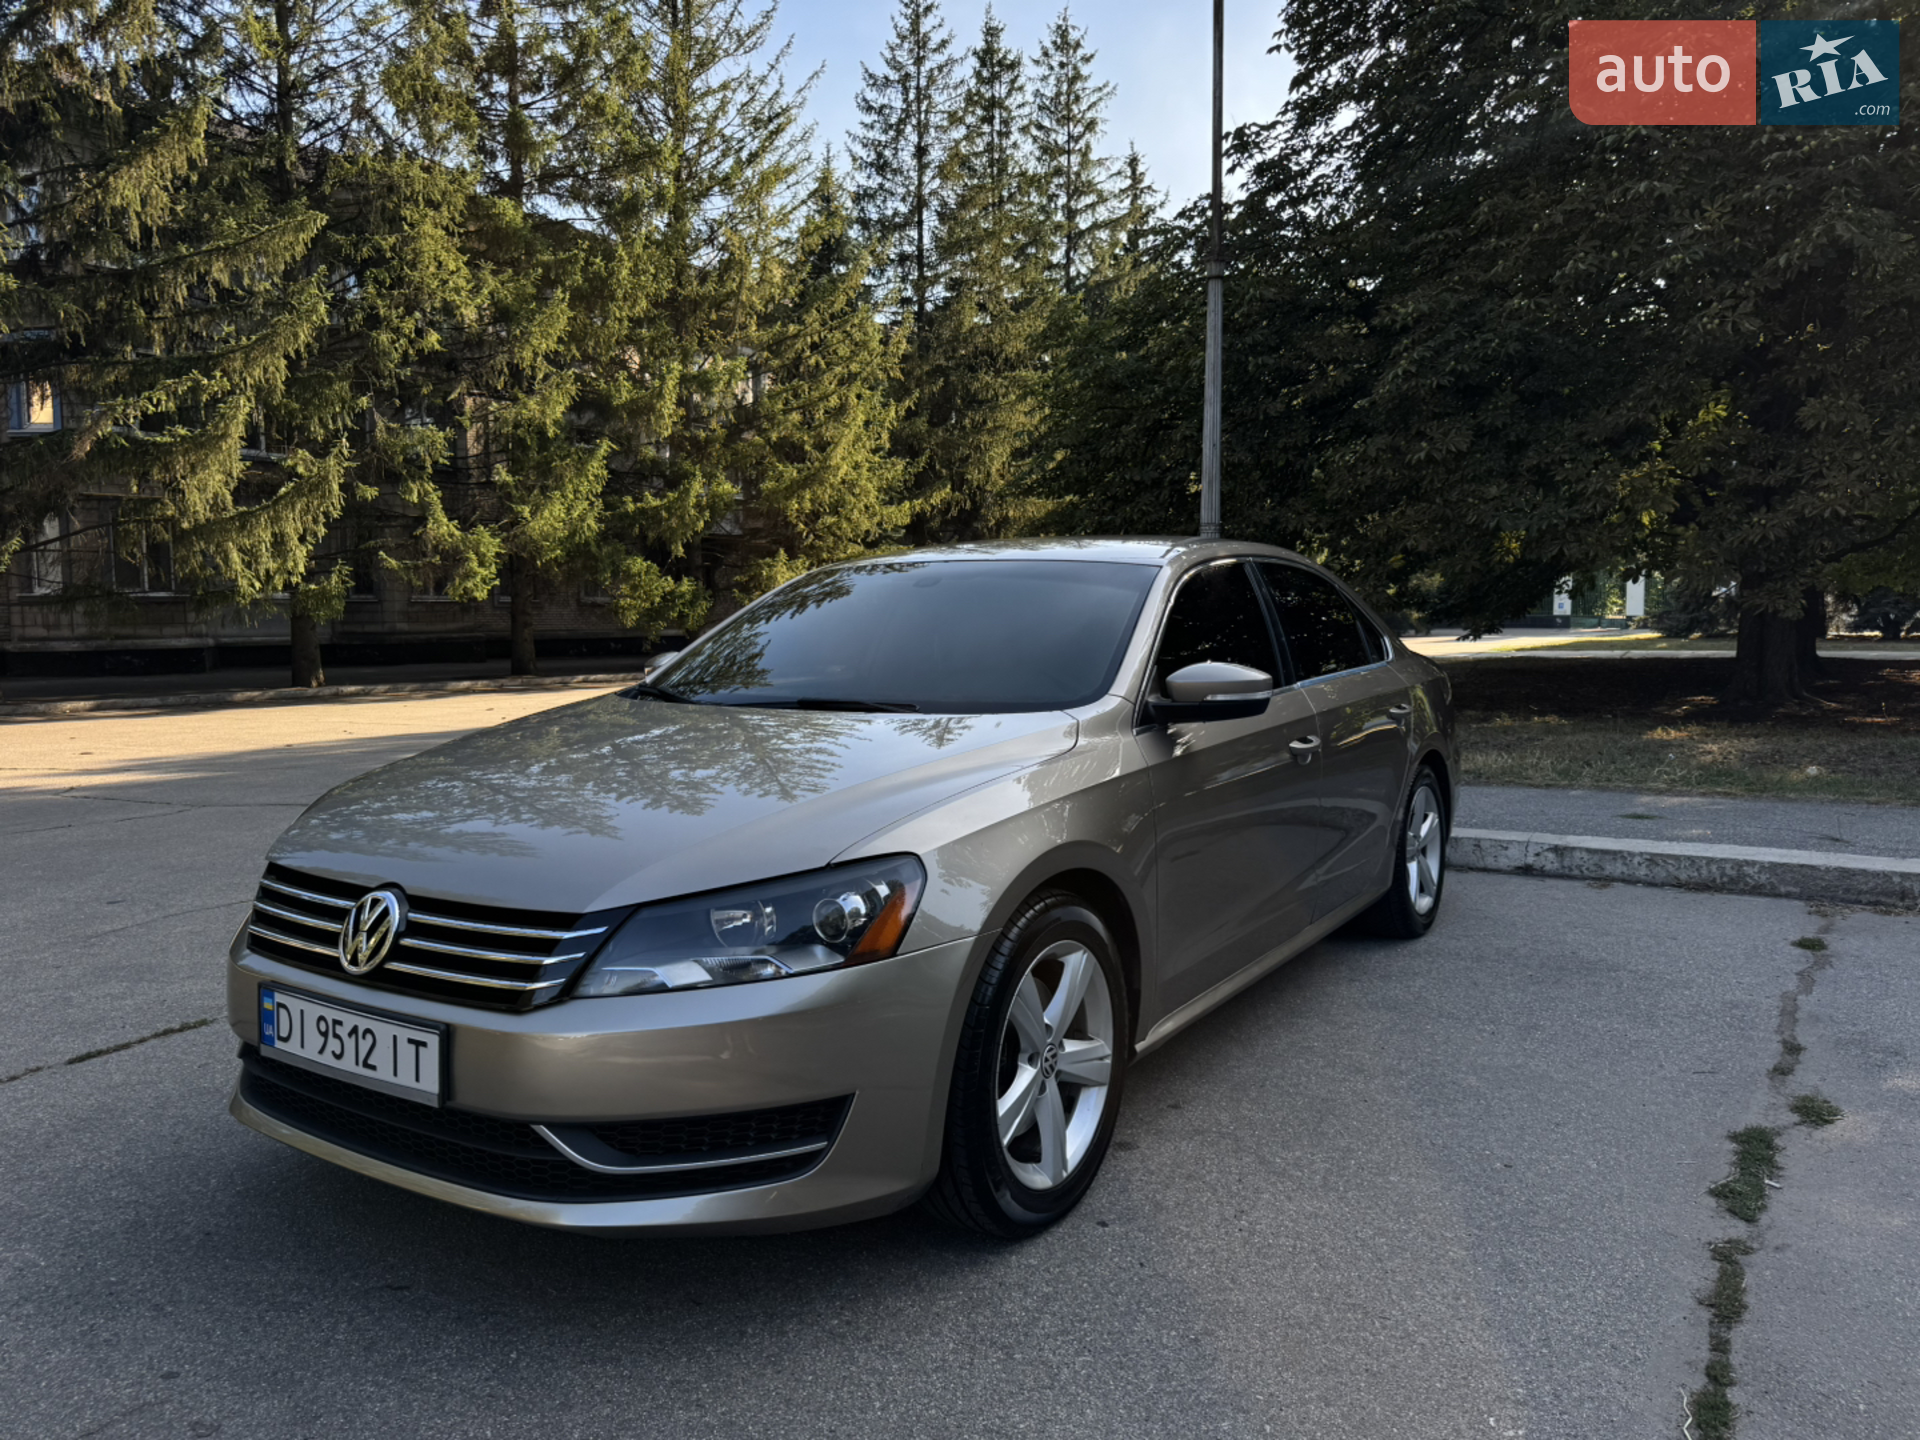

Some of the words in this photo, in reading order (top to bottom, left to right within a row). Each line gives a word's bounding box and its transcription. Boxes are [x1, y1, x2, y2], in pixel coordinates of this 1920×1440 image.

[263, 1023, 275, 1037] UA
[276, 1002, 305, 1049] DI
[316, 1015, 377, 1071] 9512
[392, 1034, 428, 1083] IT
